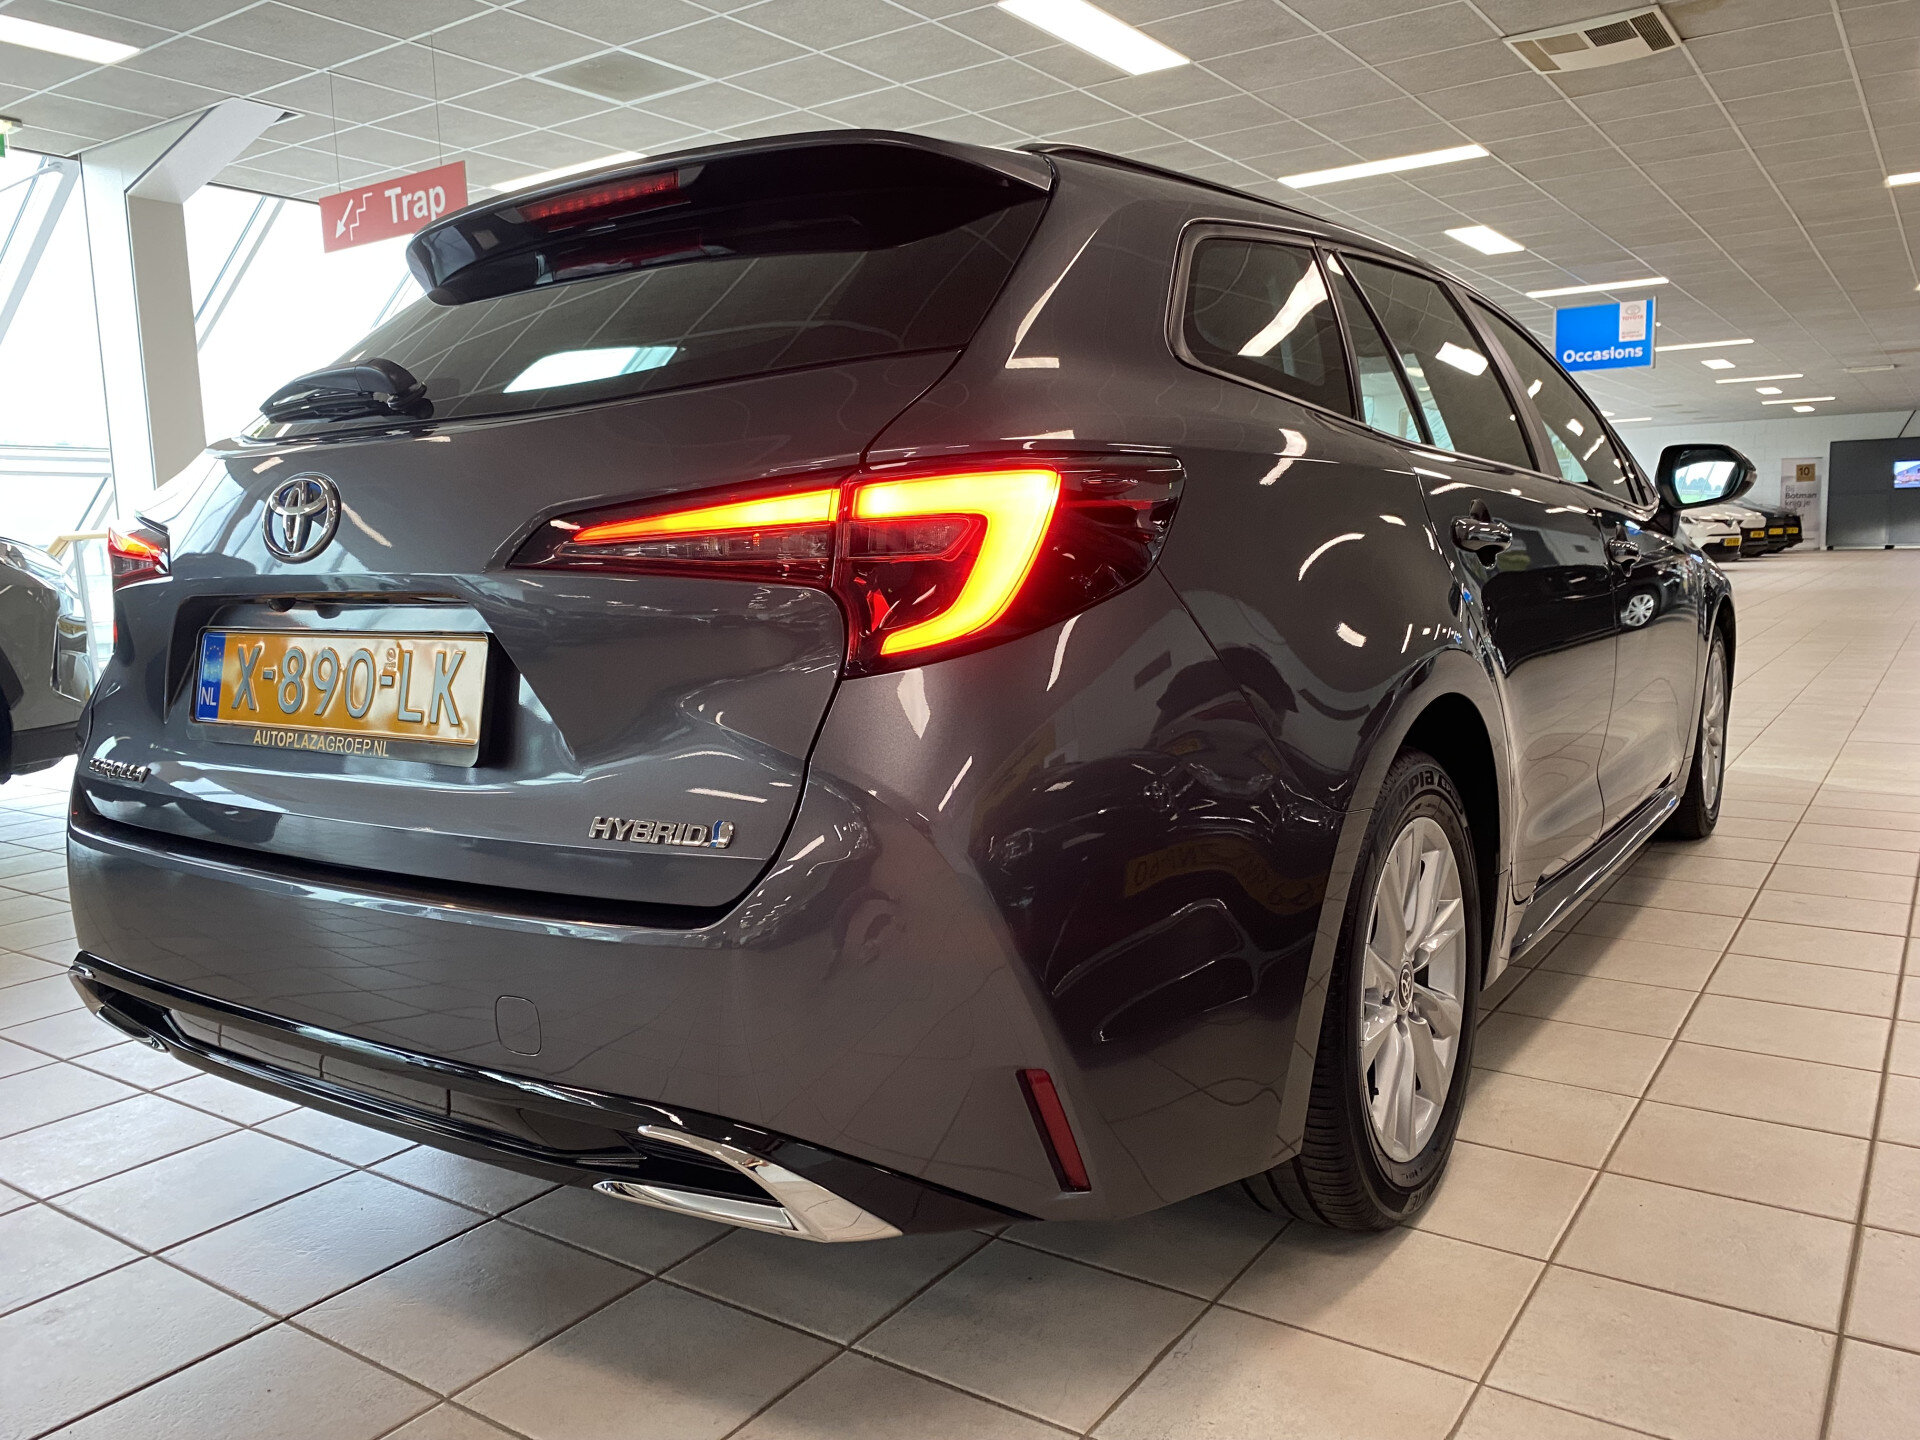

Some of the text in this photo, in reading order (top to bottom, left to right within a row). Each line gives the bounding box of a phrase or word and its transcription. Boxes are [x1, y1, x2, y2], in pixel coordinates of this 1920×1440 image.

[384, 186, 446, 224] Trap
[1563, 346, 1644, 363] Occasions
[1798, 466, 1810, 476] 10
[200, 687, 217, 706] NL
[231, 644, 467, 727] X-890-LK
[253, 729, 390, 757] AUTOPLAZAGROEP.NL
[89, 757, 149, 783] COROLLA
[588, 816, 709, 847] HYBRID
